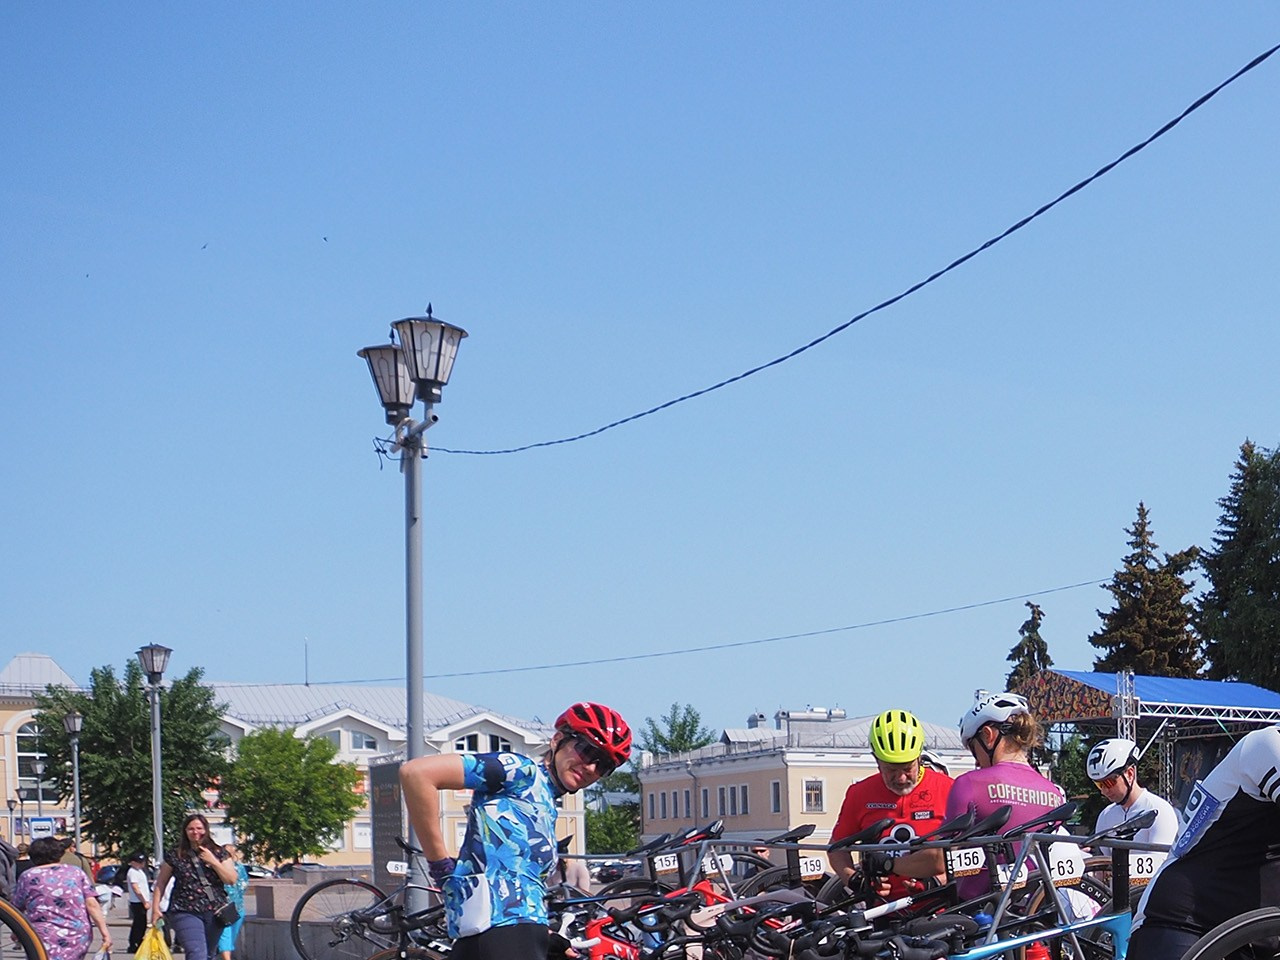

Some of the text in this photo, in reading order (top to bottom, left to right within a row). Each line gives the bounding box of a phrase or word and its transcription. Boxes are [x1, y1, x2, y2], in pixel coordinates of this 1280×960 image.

[659, 854, 678, 869] 157
[803, 858, 822, 873] 159
[956, 851, 980, 867] 156
[1136, 857, 1154, 875] 83
[1057, 859, 1075, 876] 63
